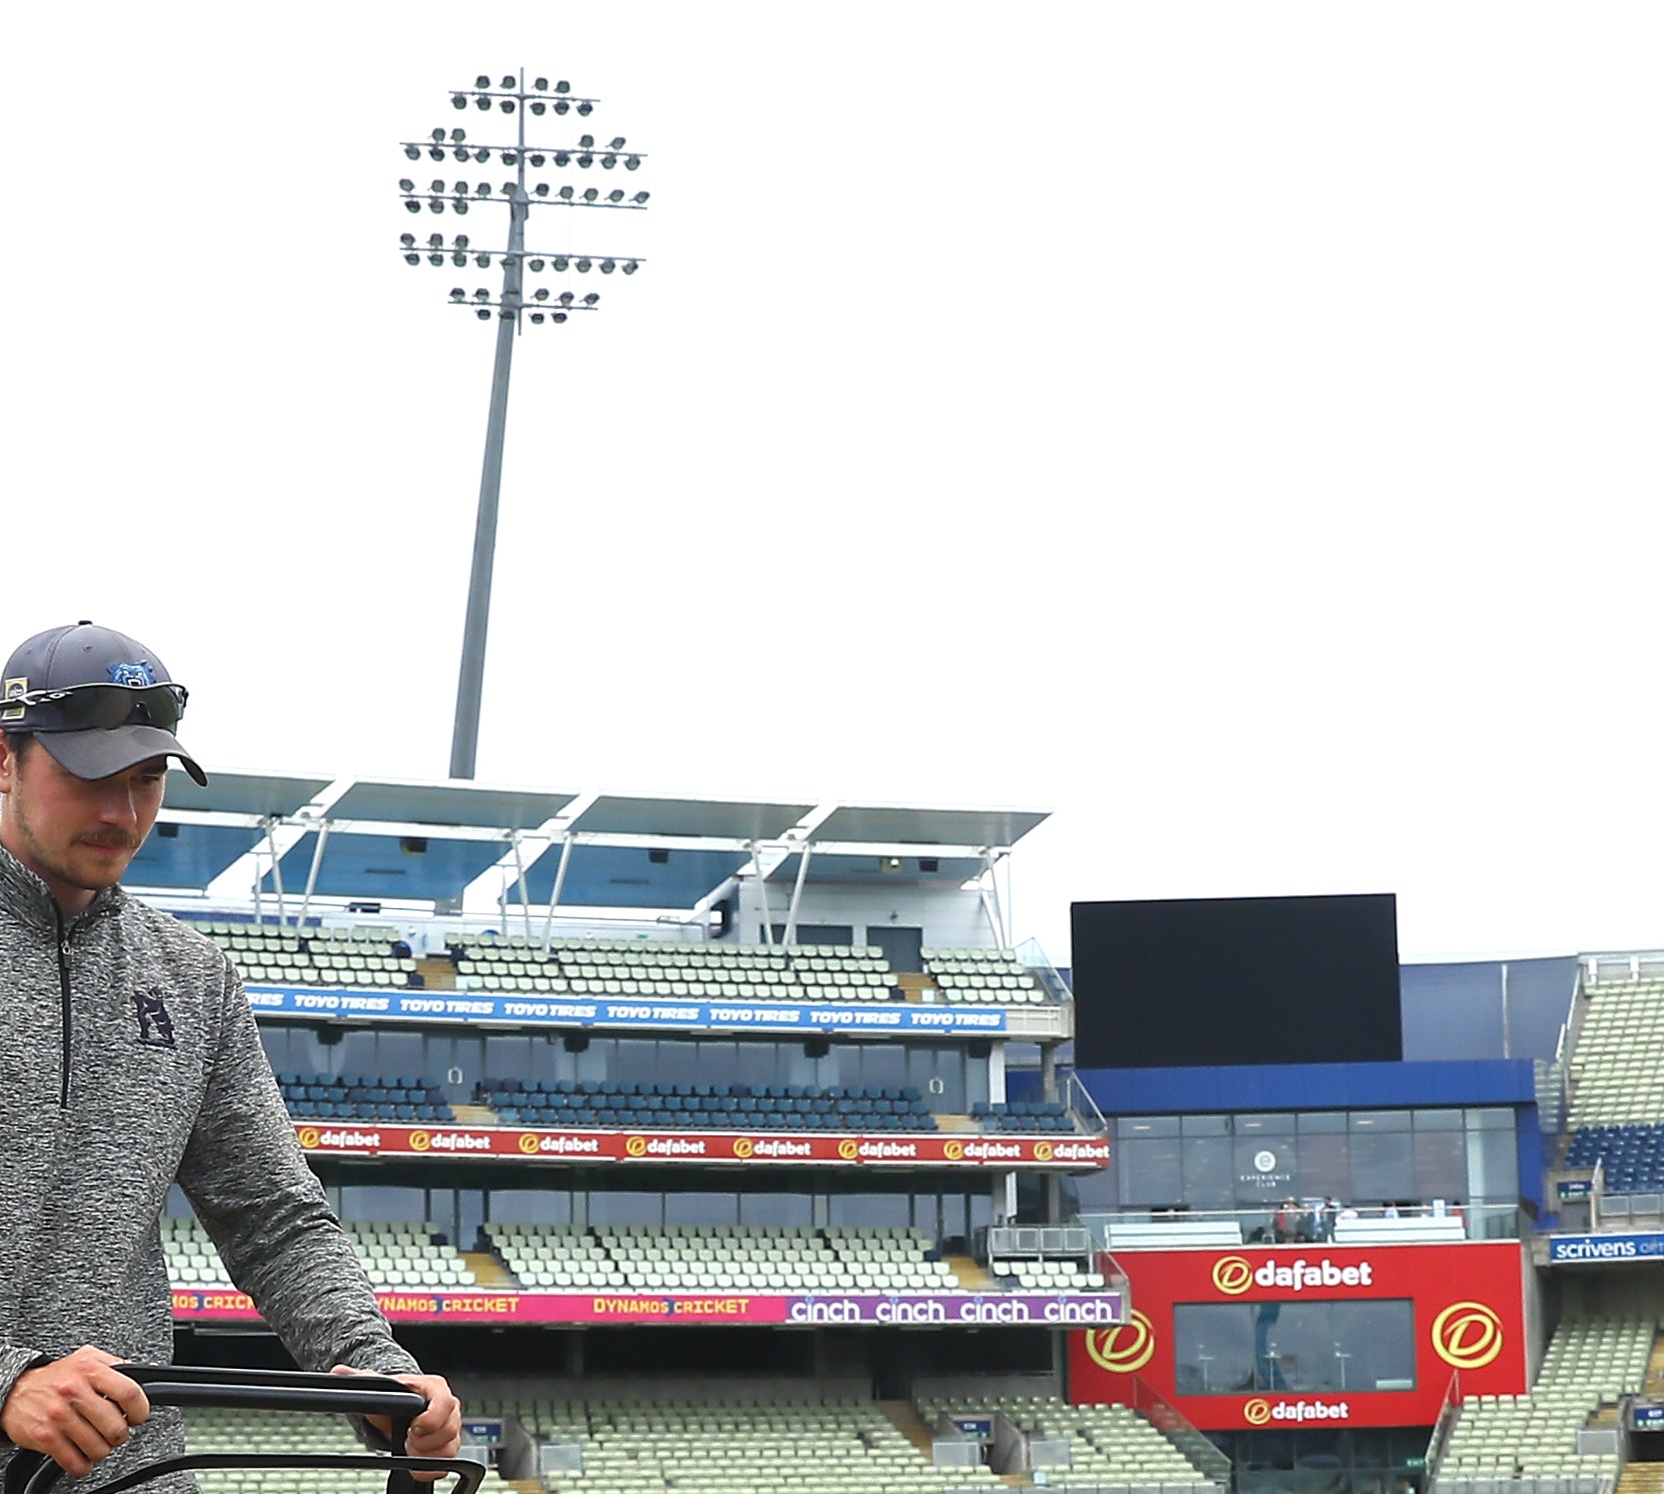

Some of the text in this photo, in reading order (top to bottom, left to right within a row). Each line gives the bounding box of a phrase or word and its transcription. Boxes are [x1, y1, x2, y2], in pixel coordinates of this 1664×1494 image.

[245, 993, 284, 1006] RES
[294, 995, 389, 1011] TOYO TIRES
[400, 999, 494, 1014] TOYO TIRES
[504, 1003, 597, 1018] TOYO TIRES
[607, 1005, 699, 1020] TOYO TIRES
[710, 1008, 800, 1023] TOYO TIRES
[810, 1010, 901, 1025] TOYO TIRES
[911, 1012, 1001, 1027] TOYO TIRES
[320, 1130, 381, 1149] dafabet
[430, 1133, 491, 1151] dafabet
[539, 1135, 598, 1153] dafabet
[647, 1137, 706, 1155] dafabet
[754, 1140, 812, 1157] dafabet
[858, 1141, 916, 1158] dafabet
[964, 1142, 1021, 1159] dafabet
[1054, 1143, 1109, 1160] dafabet
[1556, 1239, 1636, 1258] scrivens
[1254, 1260, 1373, 1291] dafabet
[377, 1297, 520, 1313] YNAMOS CRICKET
[594, 1298, 750, 1314] DYNAMOS CRICKET
[791, 1296, 861, 1322] cinch
[875, 1296, 945, 1322] cinch
[960, 1296, 1029, 1322] cinch
[1044, 1297, 1112, 1322] cinch
[1271, 1400, 1349, 1422] dafabet
